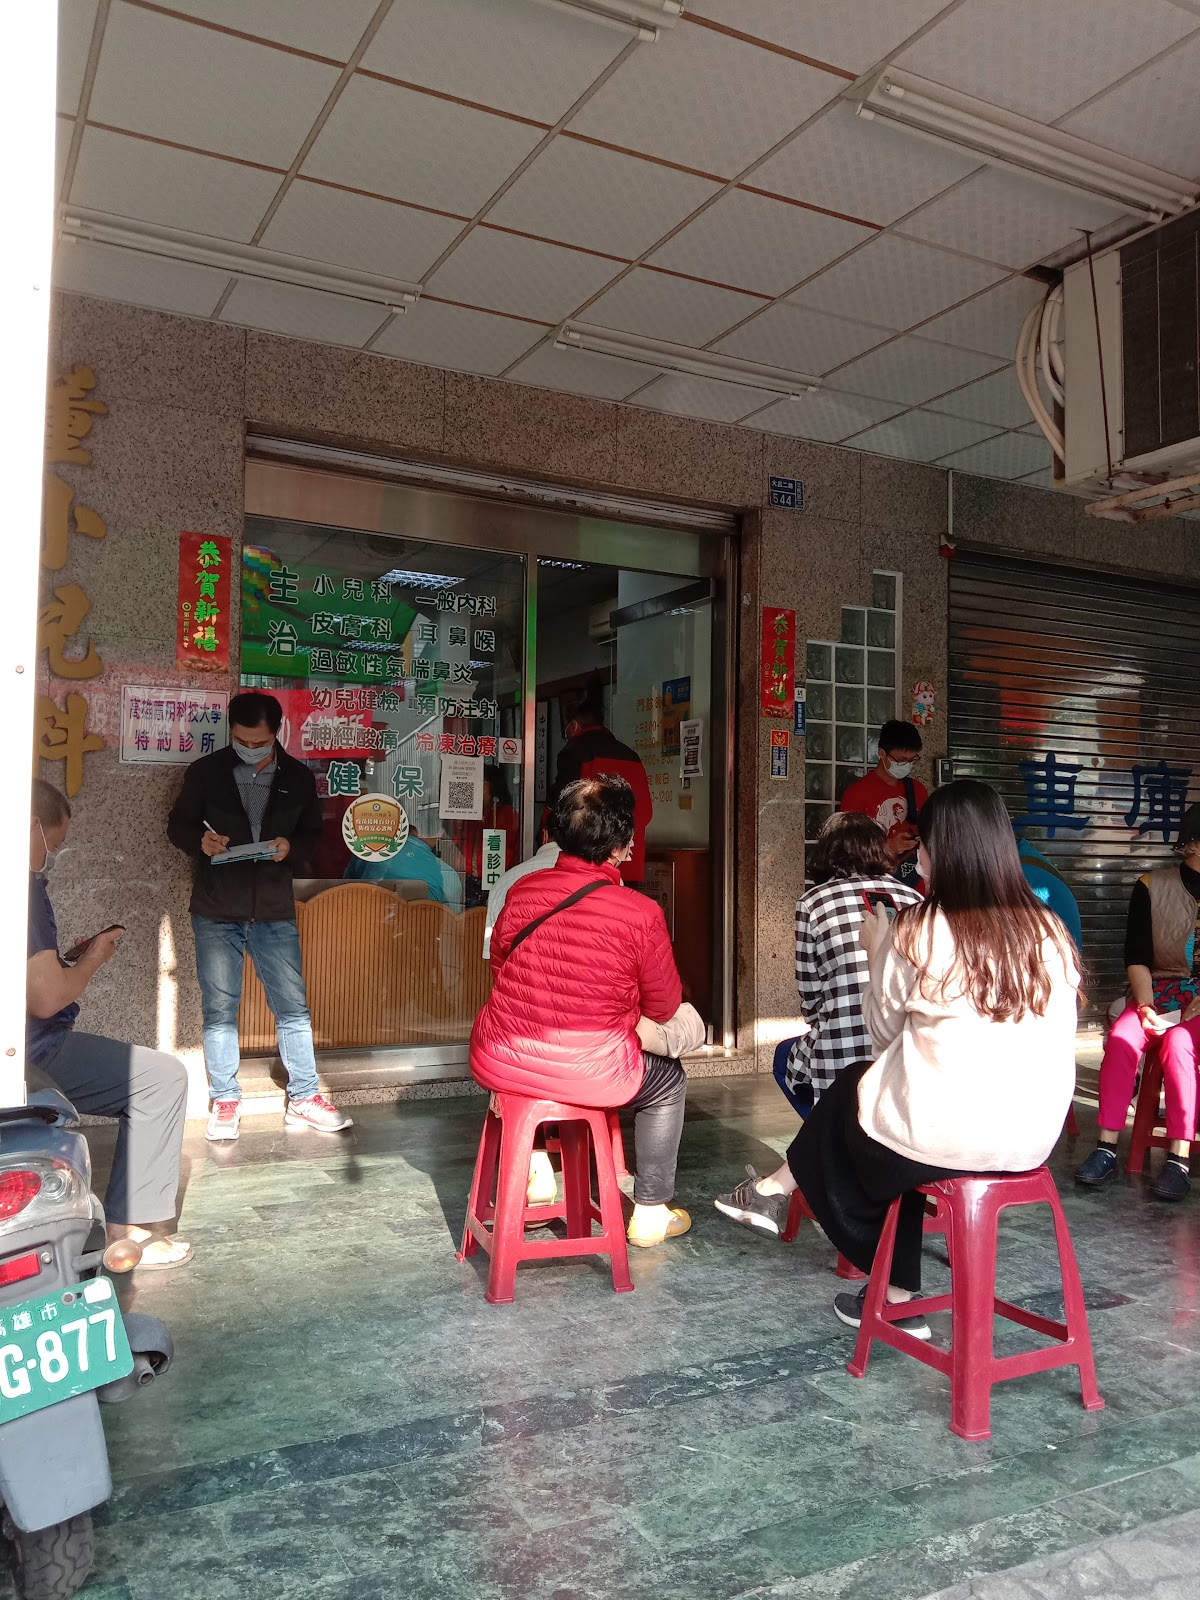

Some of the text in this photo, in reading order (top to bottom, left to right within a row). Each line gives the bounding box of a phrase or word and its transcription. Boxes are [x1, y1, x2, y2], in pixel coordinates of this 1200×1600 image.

[772, 492, 792, 507] 544
[193, 540, 223, 652] 恭賀新禧
[268, 566, 299, 656] 主治
[313, 574, 497, 617] 小兒科 一般內科
[312, 612, 496, 652] 皮膚科 耳鼻喉
[310, 687, 498, 719] 幼兒健檢 預防注射
[134, 729, 216, 754] 特約診所
[310, 724, 399, 749] 神經酸痛
[416, 731, 497, 756] 冷凍治療
[327, 761, 423, 799] 健保
[1012, 751, 1193, 843] 車庫
[487, 834, 502, 885] 看診中
[0, 1308, 117, 1399] G-877
